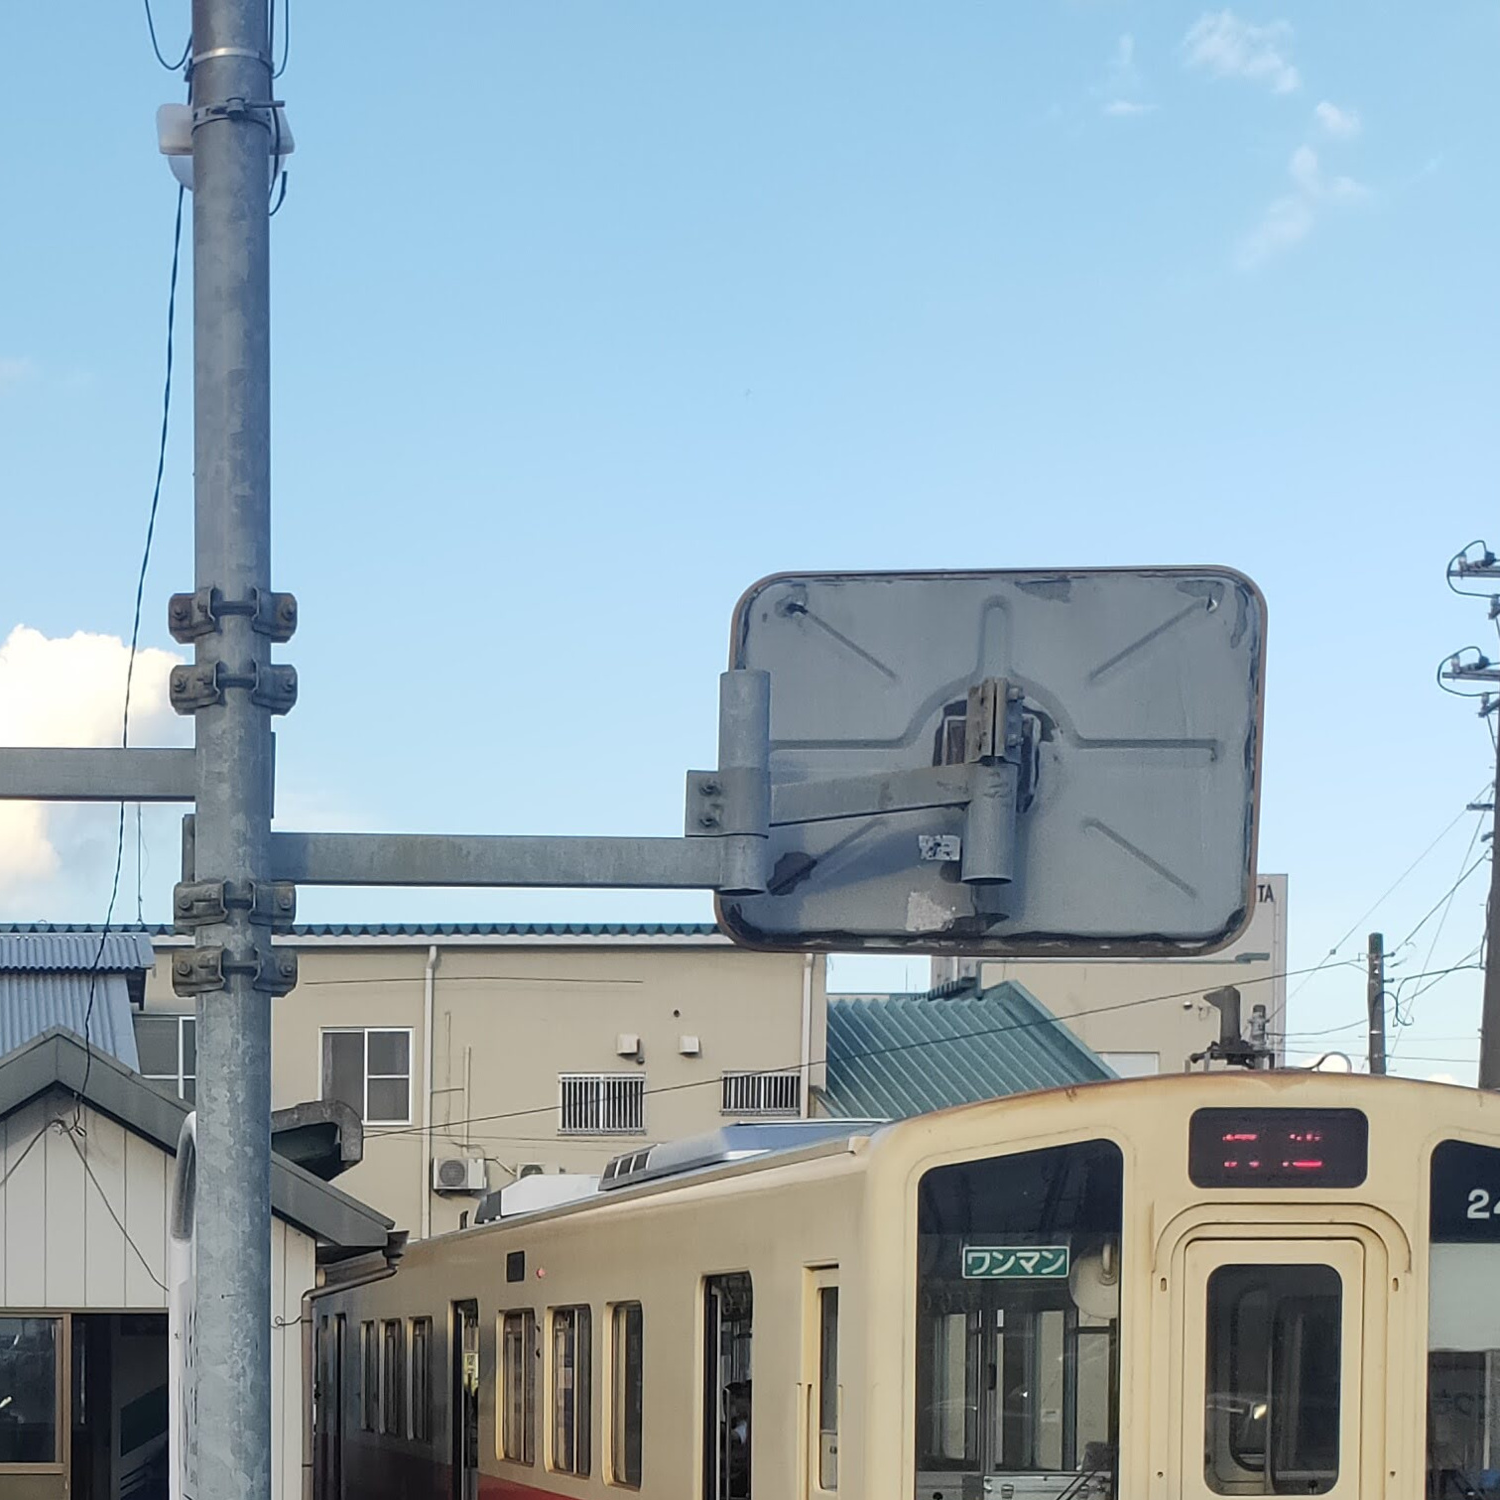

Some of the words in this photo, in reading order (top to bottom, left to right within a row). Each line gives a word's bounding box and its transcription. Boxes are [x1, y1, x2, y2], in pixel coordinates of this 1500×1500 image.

[1257, 884, 1275, 903] TA
[967, 1250, 1066, 1275] ワンマン
